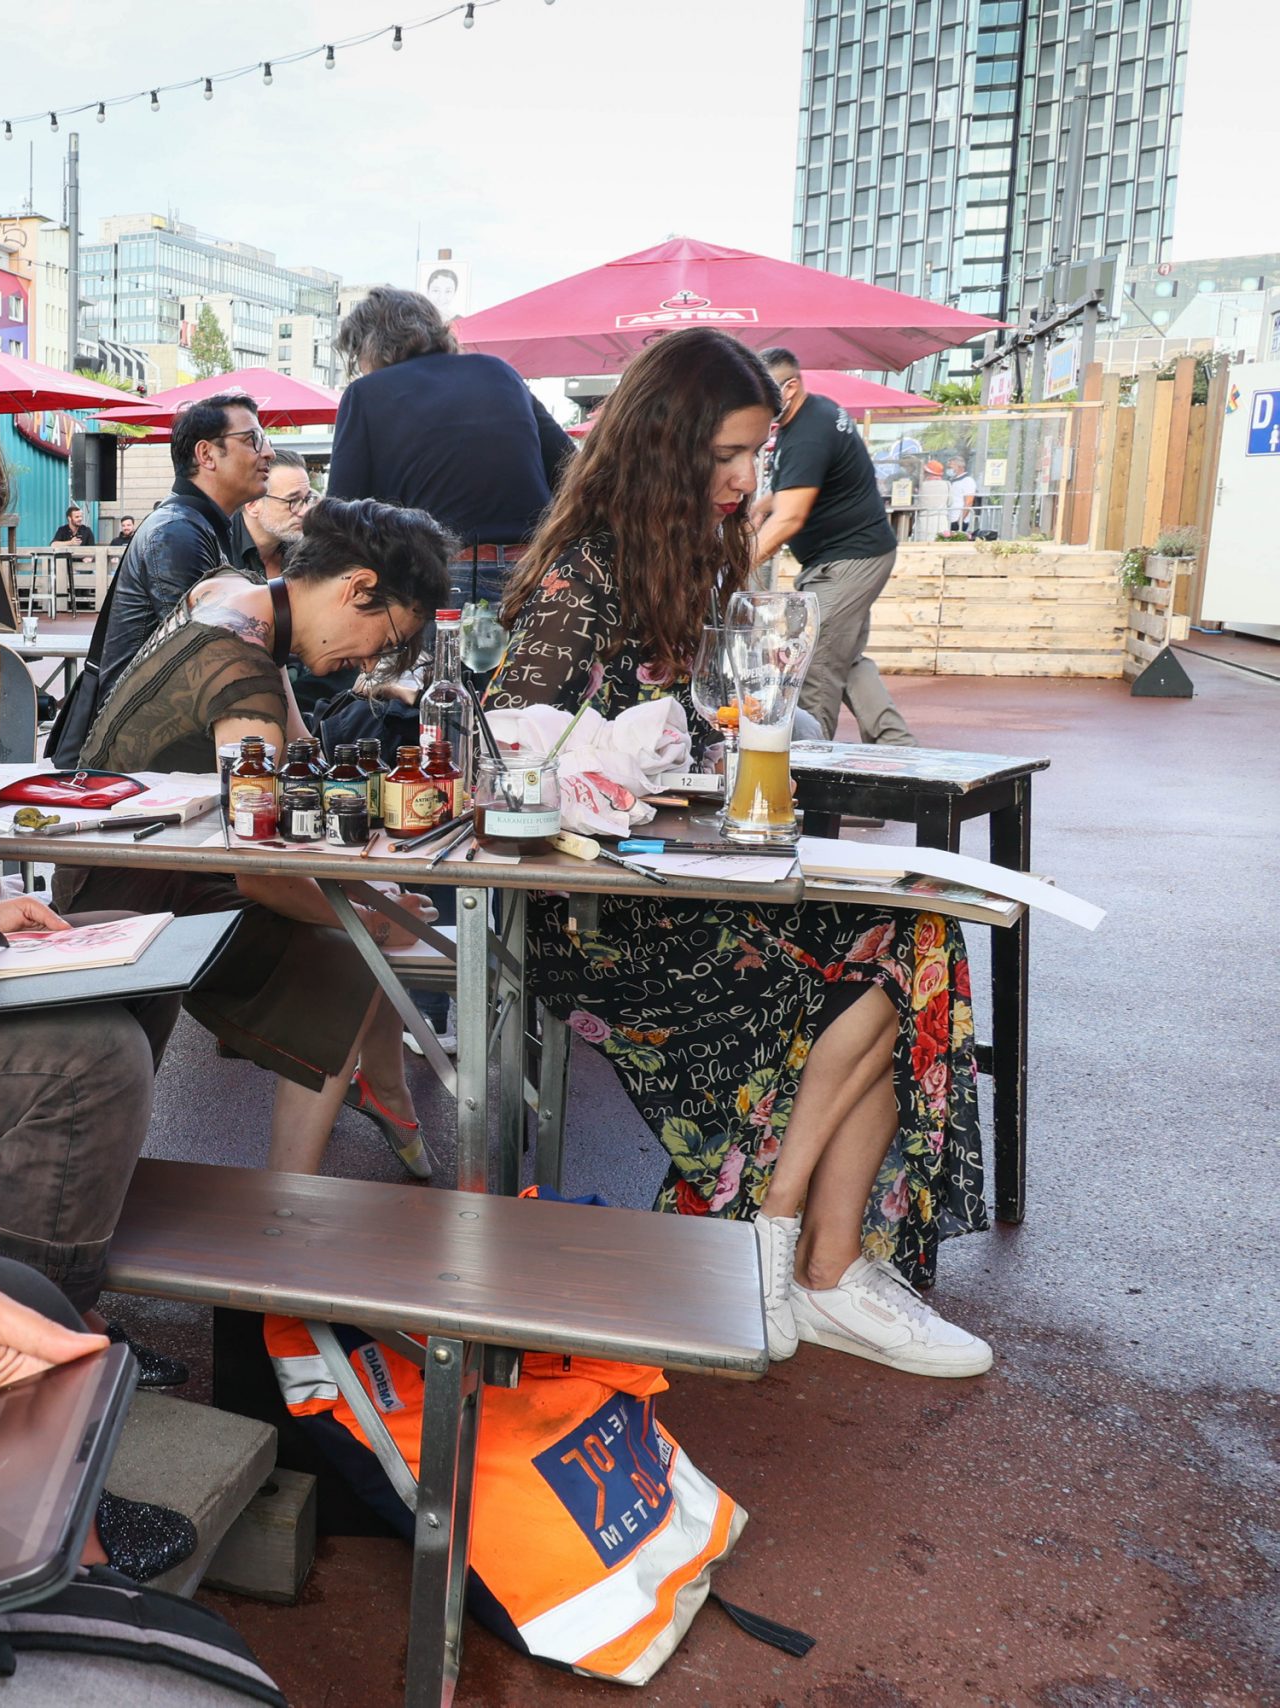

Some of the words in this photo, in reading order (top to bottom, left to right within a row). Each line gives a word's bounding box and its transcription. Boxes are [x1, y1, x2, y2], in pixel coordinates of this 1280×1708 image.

[627, 311, 716, 325] ASTRA
[681, 777, 693, 787] 12
[623, 1071, 679, 1096] NEW
[363, 1347, 394, 1408] DIADEMA
